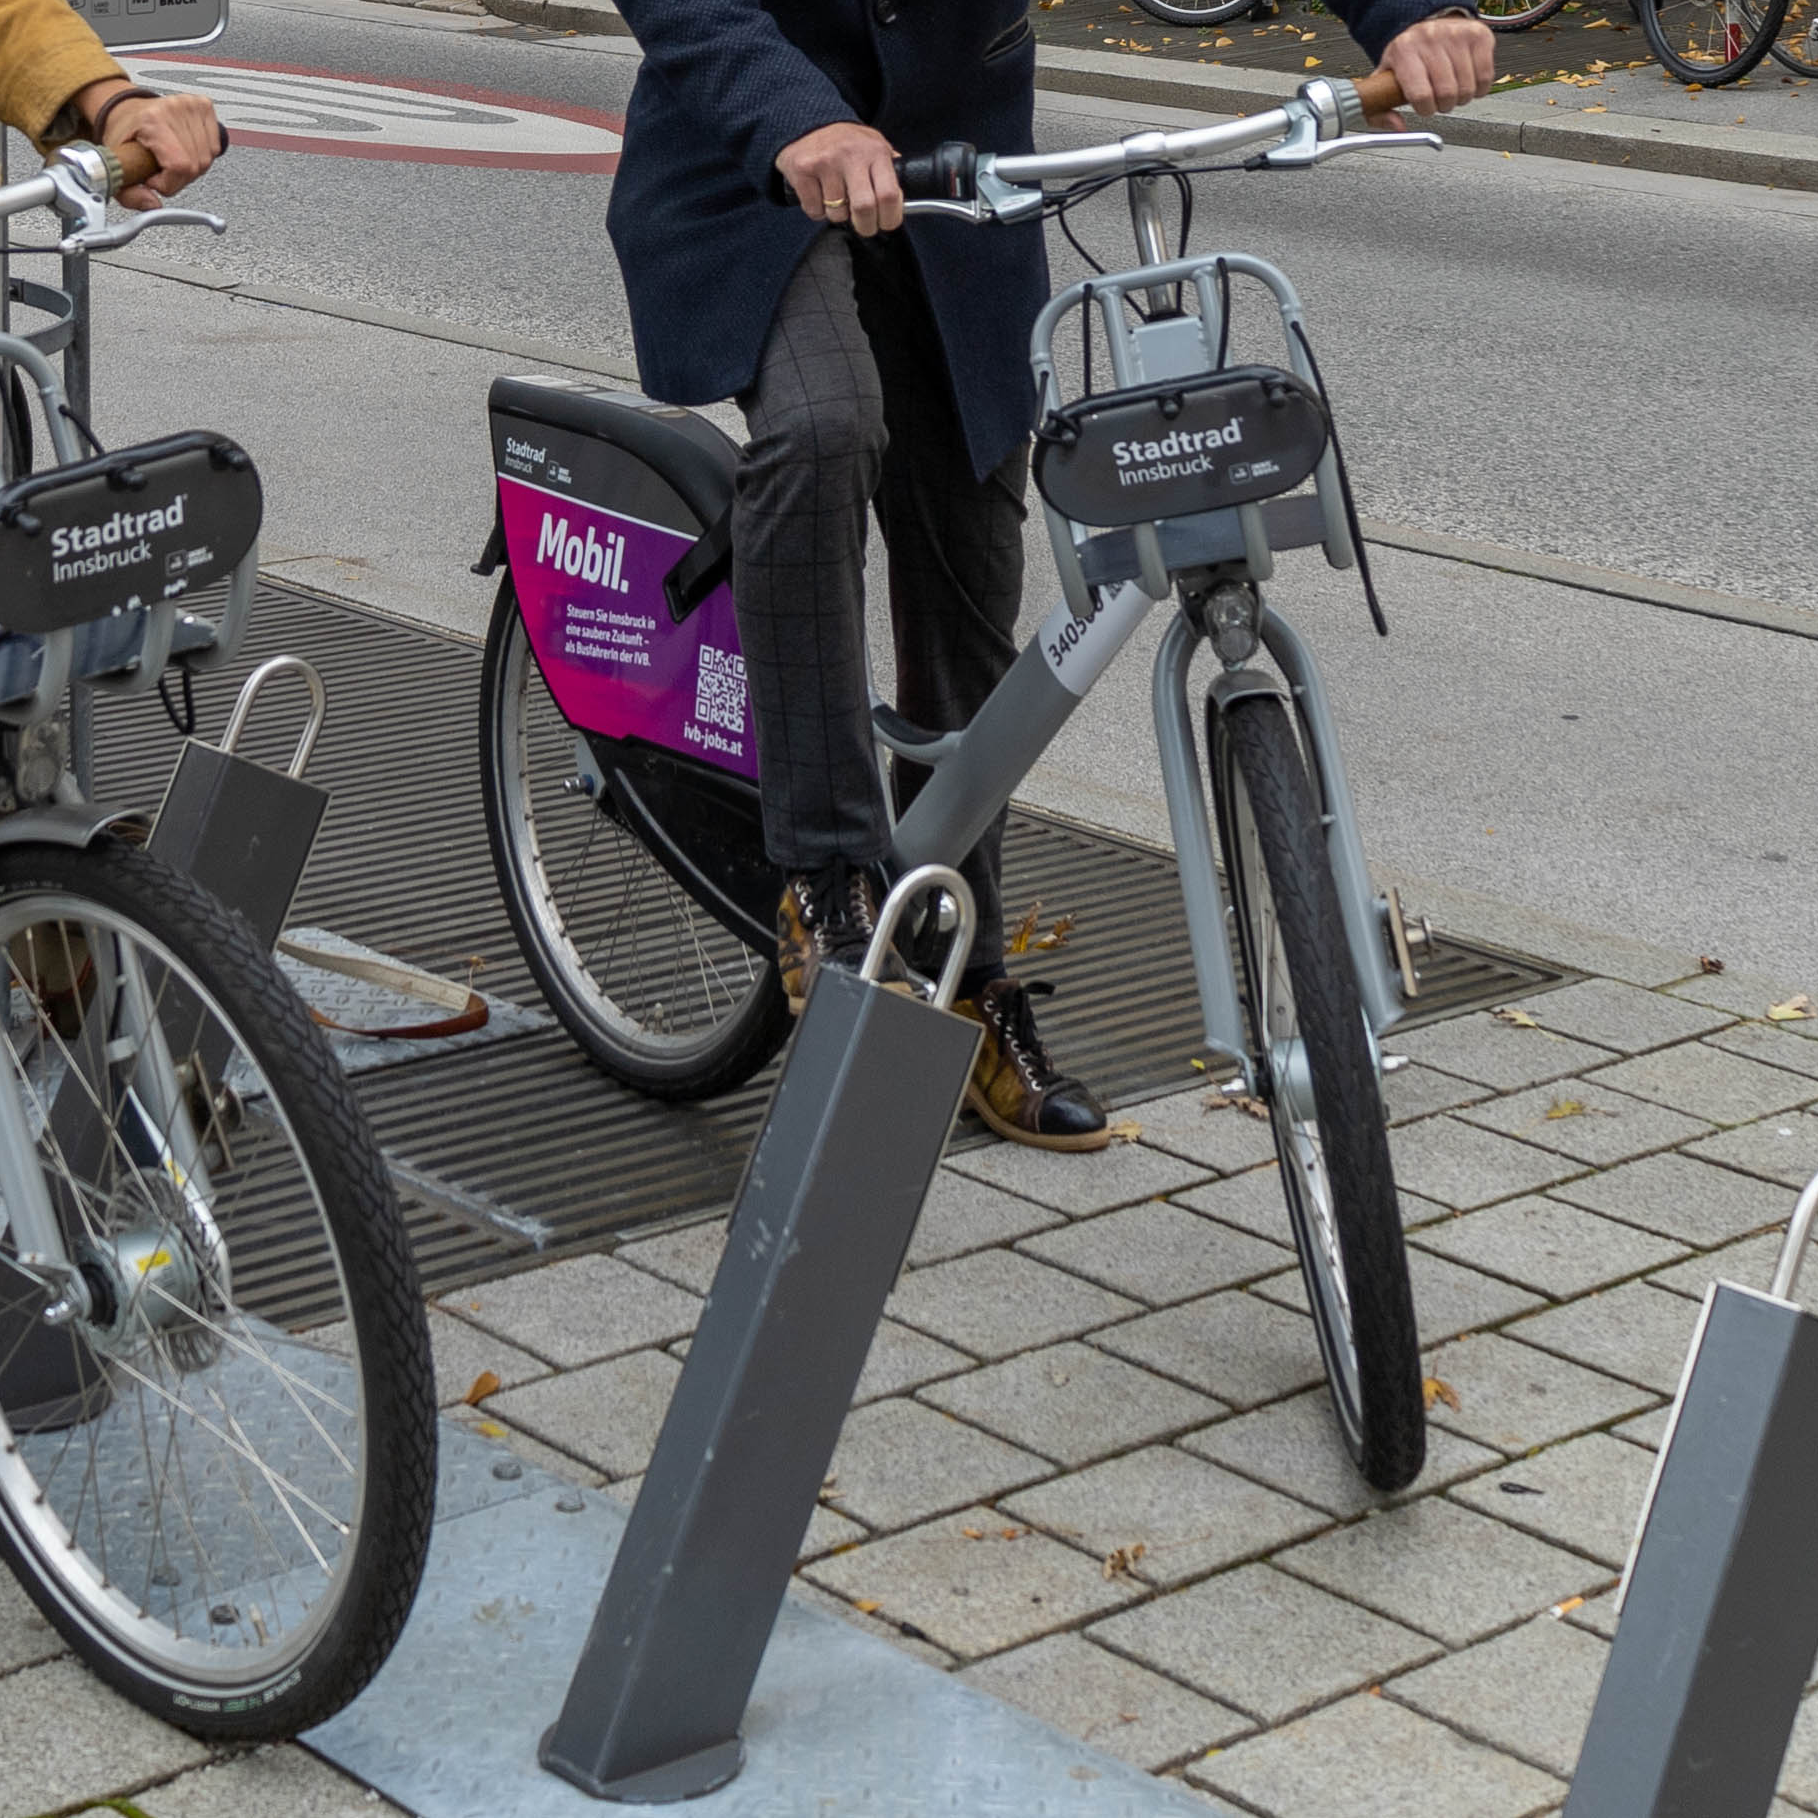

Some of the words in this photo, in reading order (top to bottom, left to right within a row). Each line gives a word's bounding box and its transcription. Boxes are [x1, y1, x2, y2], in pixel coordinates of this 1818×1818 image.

[505, 437, 547, 464] Stadtrad
[1112, 417, 1243, 467] Stadtrad
[1118, 454, 1215, 487] Innsbruck
[51, 494, 185, 558] Stadtrad
[53, 539, 153, 583] Innsbruck
[536, 512, 630, 594] Mobil.
[566, 603, 595, 621] Steuern
[596, 609, 608, 623] Sie
[609, 611, 646, 629] Innsbruck
[647, 616, 657, 630] in
[565, 622, 581, 637] eine
[582, 626, 611, 642] saubere
[611, 629, 643, 647] Zukunft
[565, 640, 576, 654] als
[619, 649, 633, 663] der
[634, 651, 652, 667] IVB.
[684, 721, 744, 757] ivb-jobs.at
